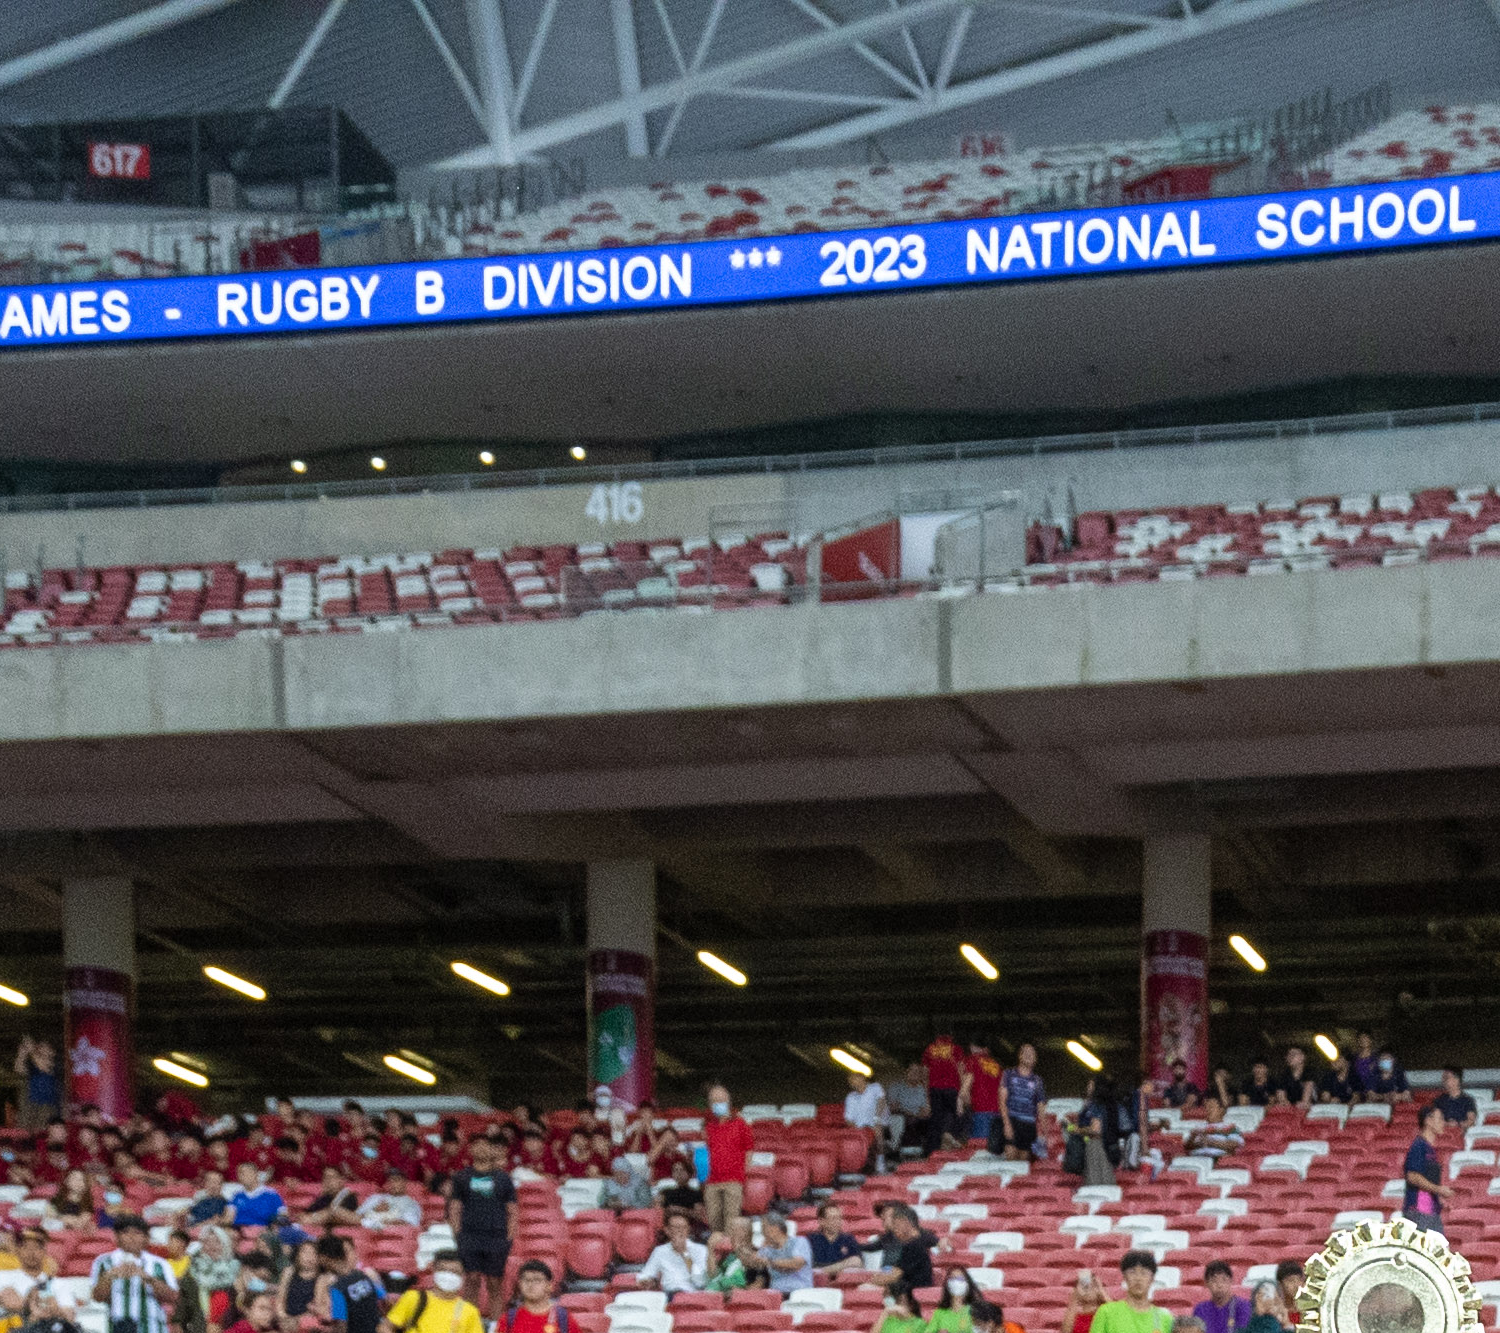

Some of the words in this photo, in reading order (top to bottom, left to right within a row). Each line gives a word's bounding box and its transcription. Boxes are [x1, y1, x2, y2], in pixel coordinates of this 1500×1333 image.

[92, 142, 142, 176] 617
[217, 274, 380, 327] RUGBY
[415, 270, 445, 315] B
[483, 252, 693, 311] DIVISION
[819, 234, 927, 287] 2023
[966, 210, 1217, 274] NATIONAL
[1256, 185, 1477, 250] SCHOOL
[584, 480, 644, 524] 416
